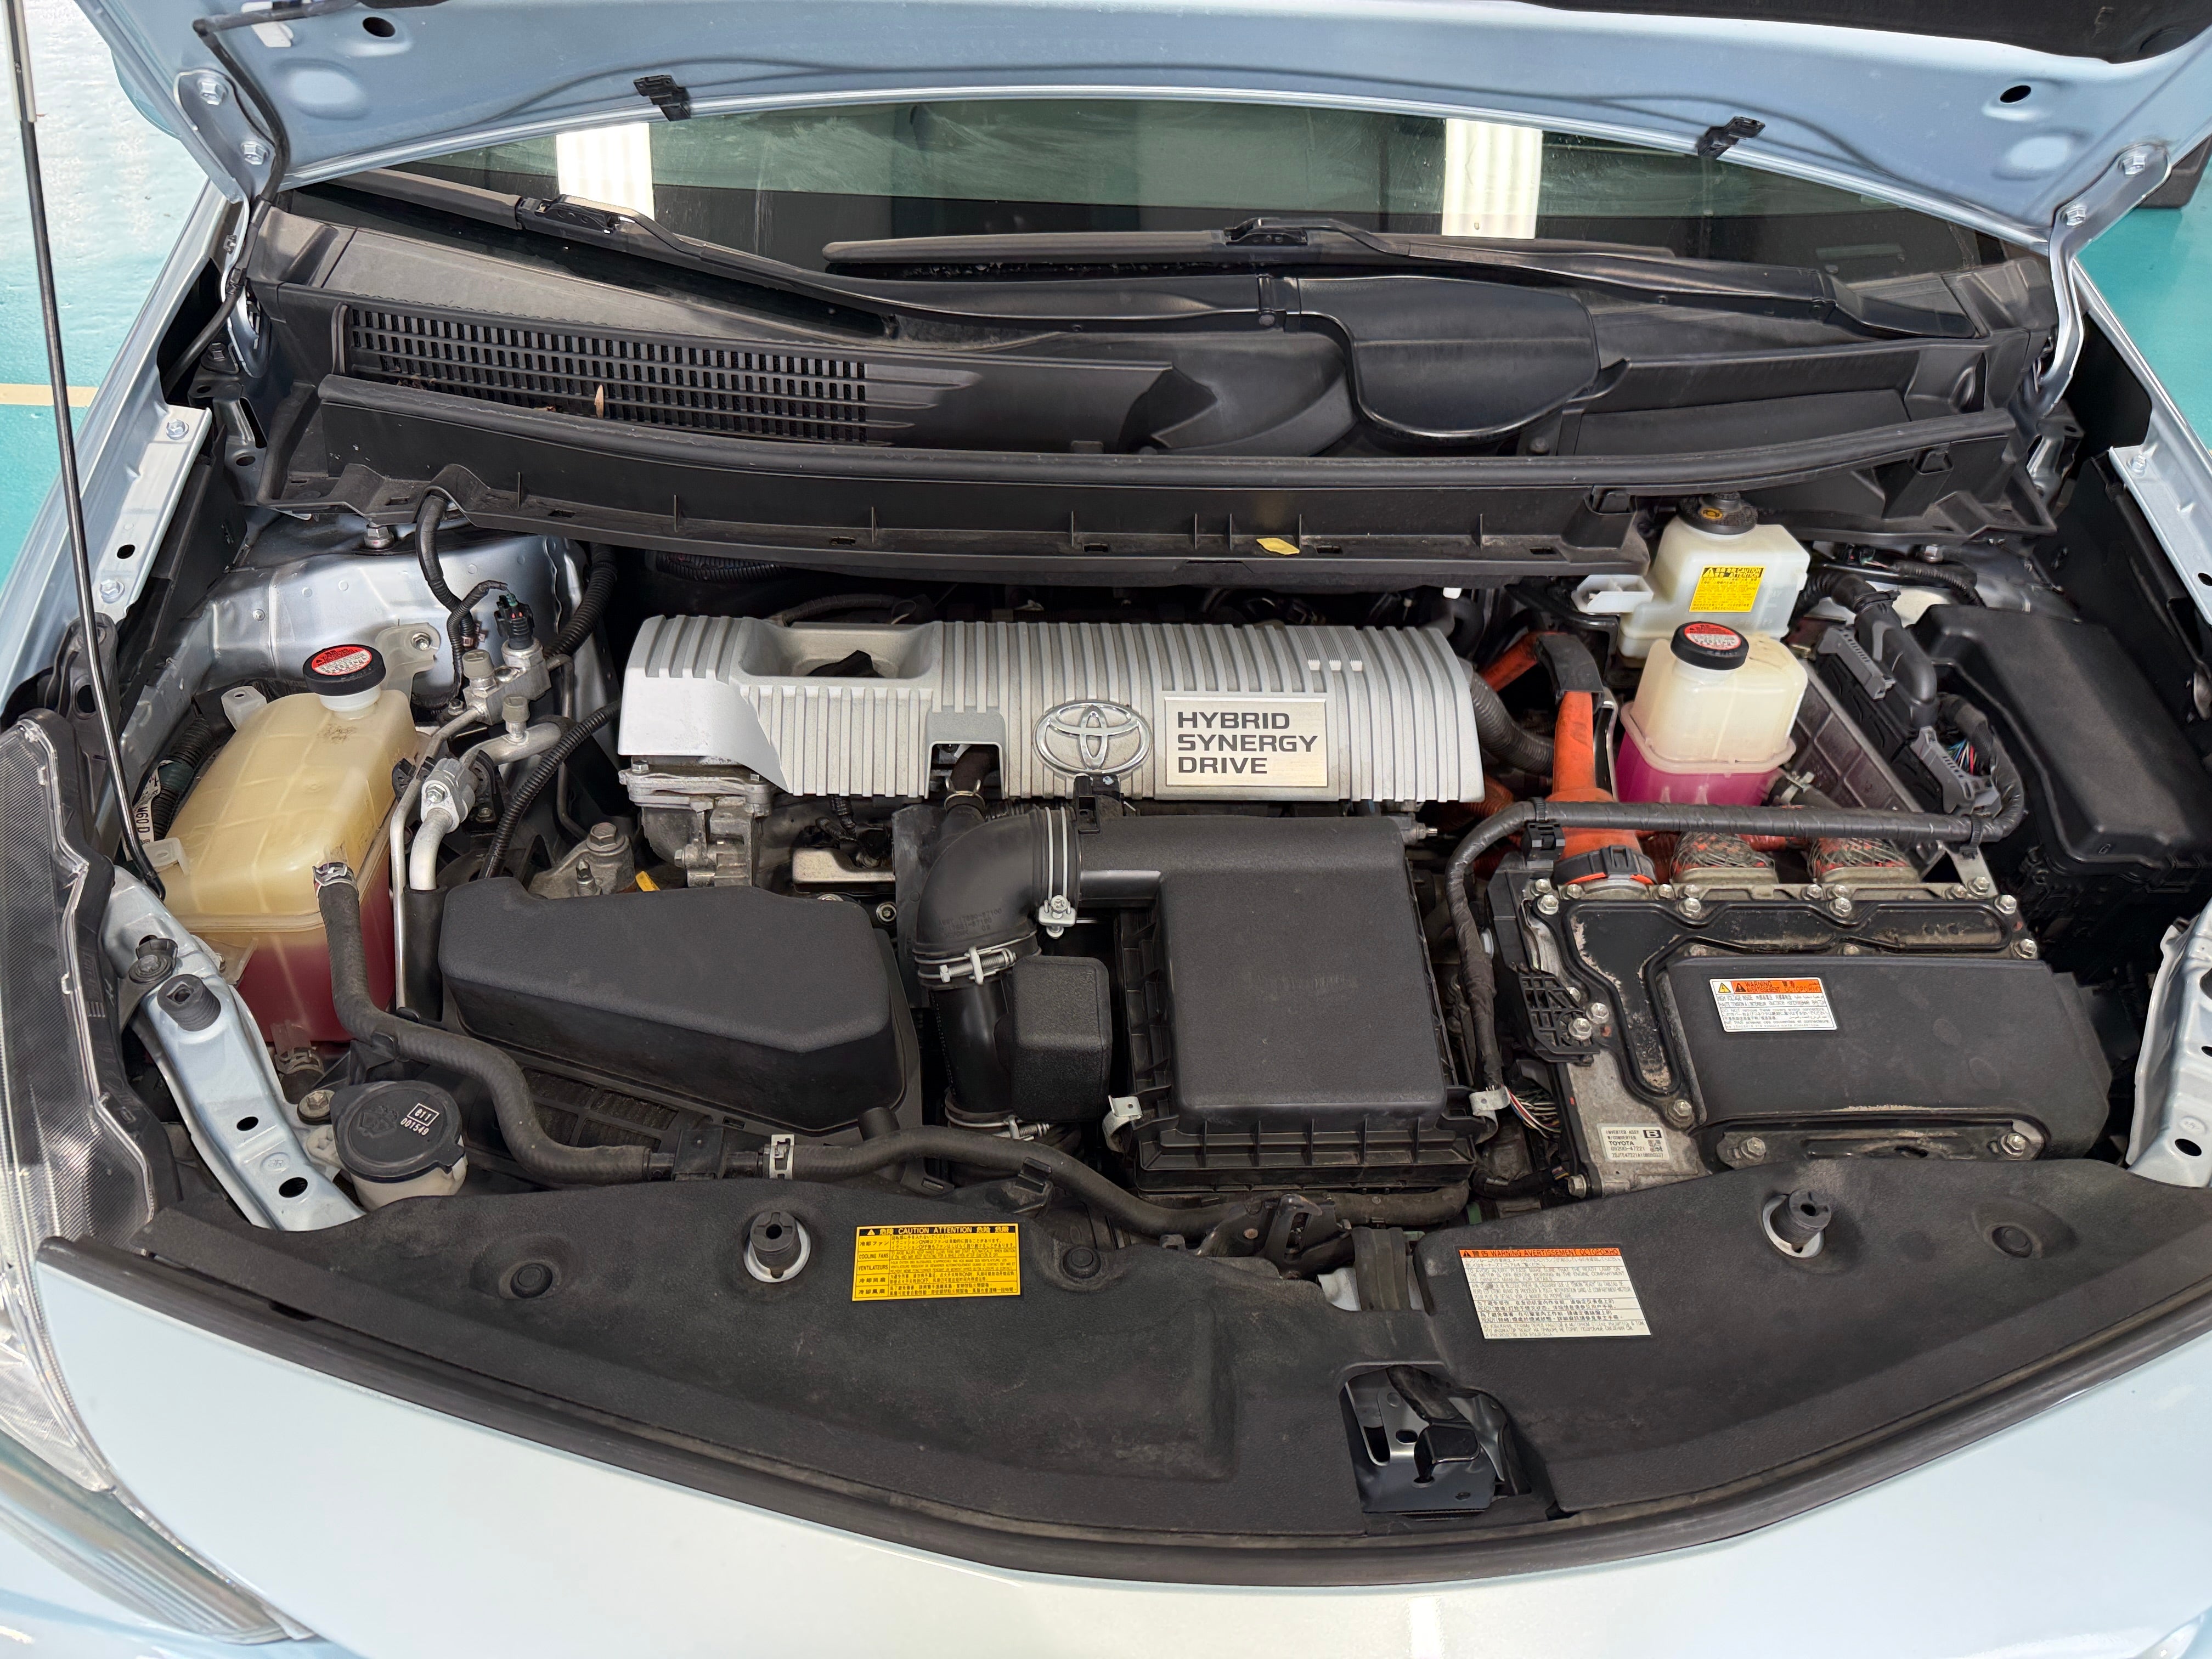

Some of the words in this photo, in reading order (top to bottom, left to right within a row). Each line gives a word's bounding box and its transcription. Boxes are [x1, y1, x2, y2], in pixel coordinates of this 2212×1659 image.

[1177, 712, 1290, 729] HYBRID
[1177, 734, 1318, 752] SYNERGY
[1178, 757, 1267, 774] DRIVE
[414, 1108, 432, 1121] e11
[400, 1118, 430, 1136] 001549
[1645, 1130, 1660, 1138] B
